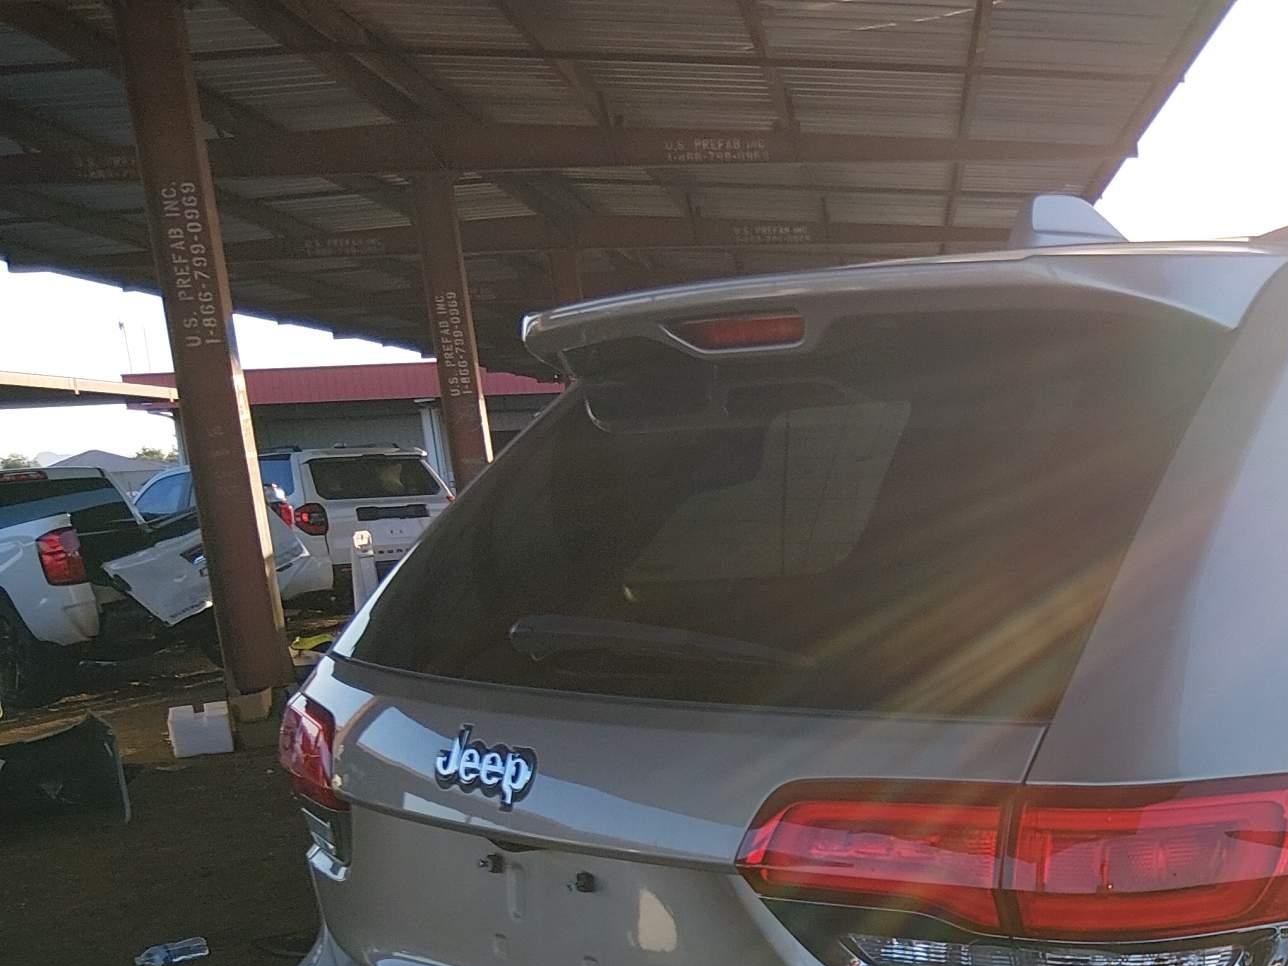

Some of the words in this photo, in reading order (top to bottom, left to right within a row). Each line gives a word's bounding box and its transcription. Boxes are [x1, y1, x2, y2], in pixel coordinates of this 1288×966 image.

[161, 182, 181, 217] INC.
[168, 227, 195, 301] PREFAB
[180, 182, 222, 344] 1-866-799-0969
[438, 320, 457, 367] PREFAB
[434, 724, 536, 810] Jeep
